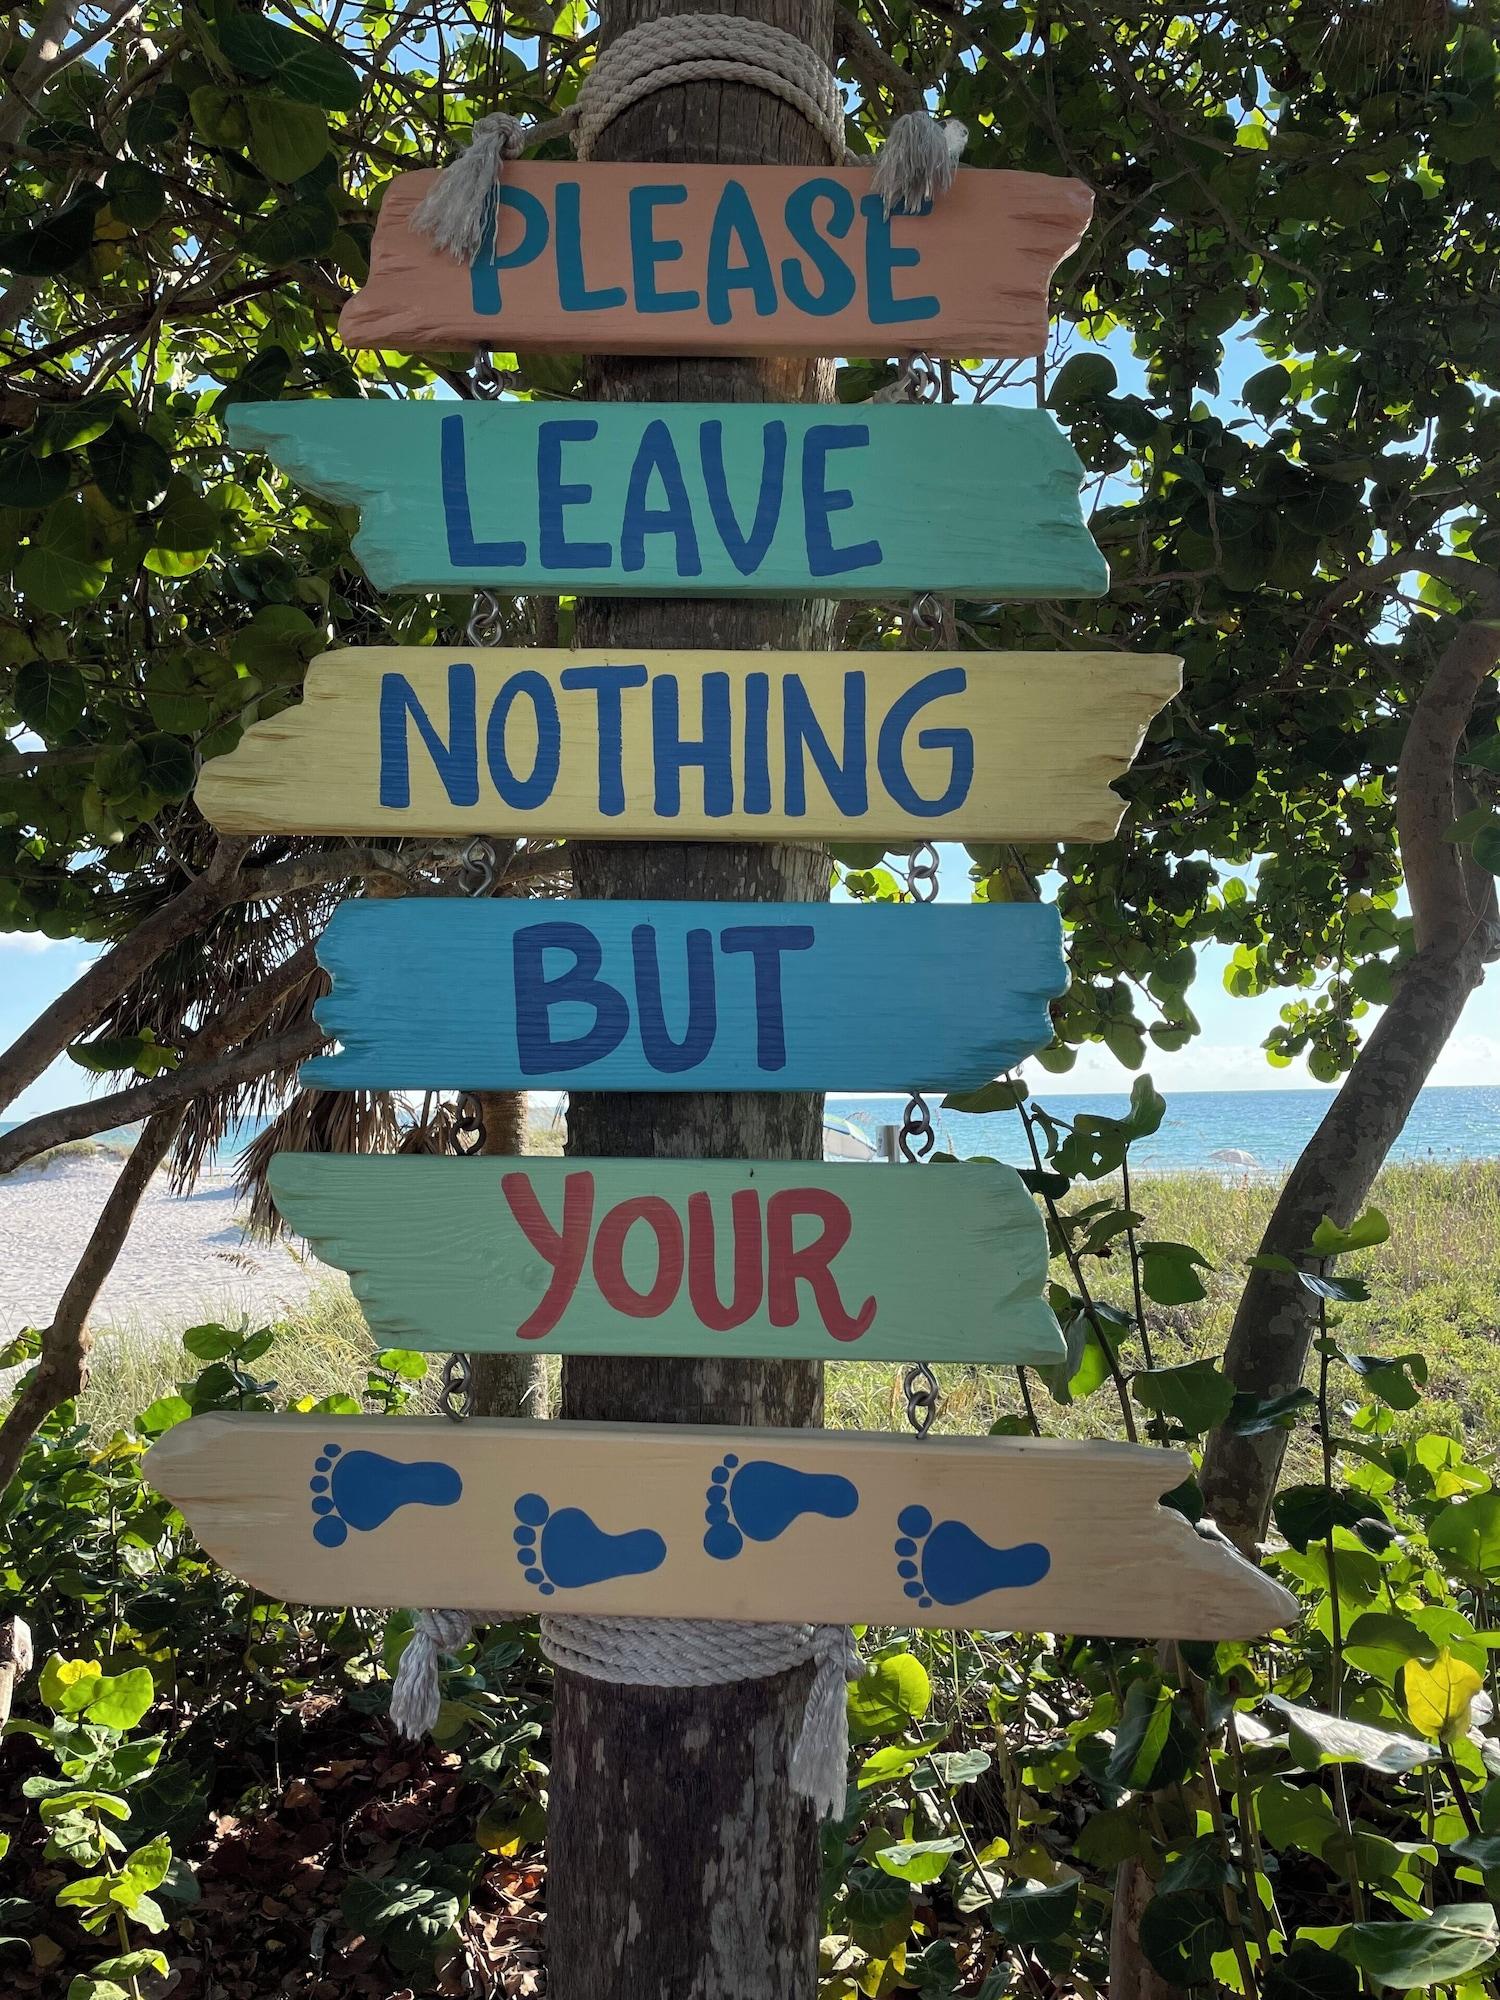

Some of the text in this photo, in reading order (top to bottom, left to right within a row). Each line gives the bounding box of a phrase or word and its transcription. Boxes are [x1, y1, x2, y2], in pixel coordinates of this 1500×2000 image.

[471, 177, 940, 325] PLEASE
[441, 415, 883, 577] LEAVE
[379, 664, 974, 818] NOTHING
[512, 921, 815, 1075] BUT
[501, 1170, 877, 1343] YOUR
